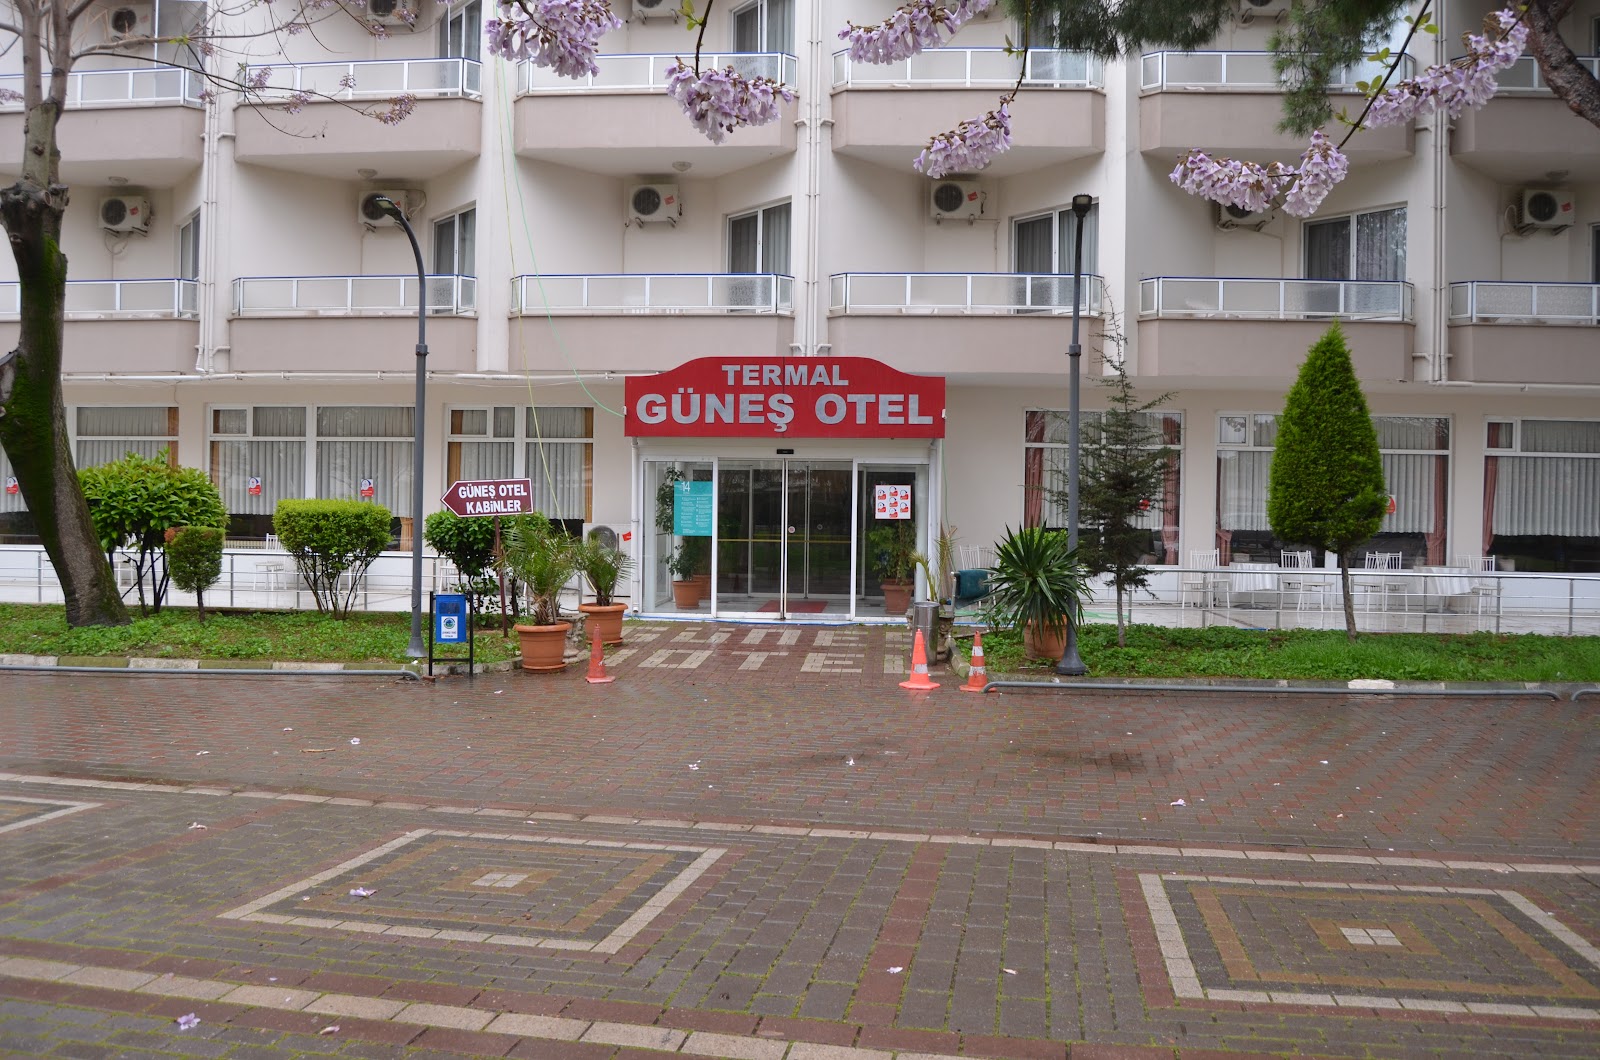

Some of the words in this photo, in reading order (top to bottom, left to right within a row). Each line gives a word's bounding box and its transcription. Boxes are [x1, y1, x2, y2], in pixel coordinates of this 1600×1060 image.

[721, 364, 849, 386] TERMAL
[635, 387, 795, 433] GÜNEŞ
[814, 393, 934, 425] OTEL
[458, 483, 496, 499] GÜNEŞ
[498, 484, 528, 497] OTEL
